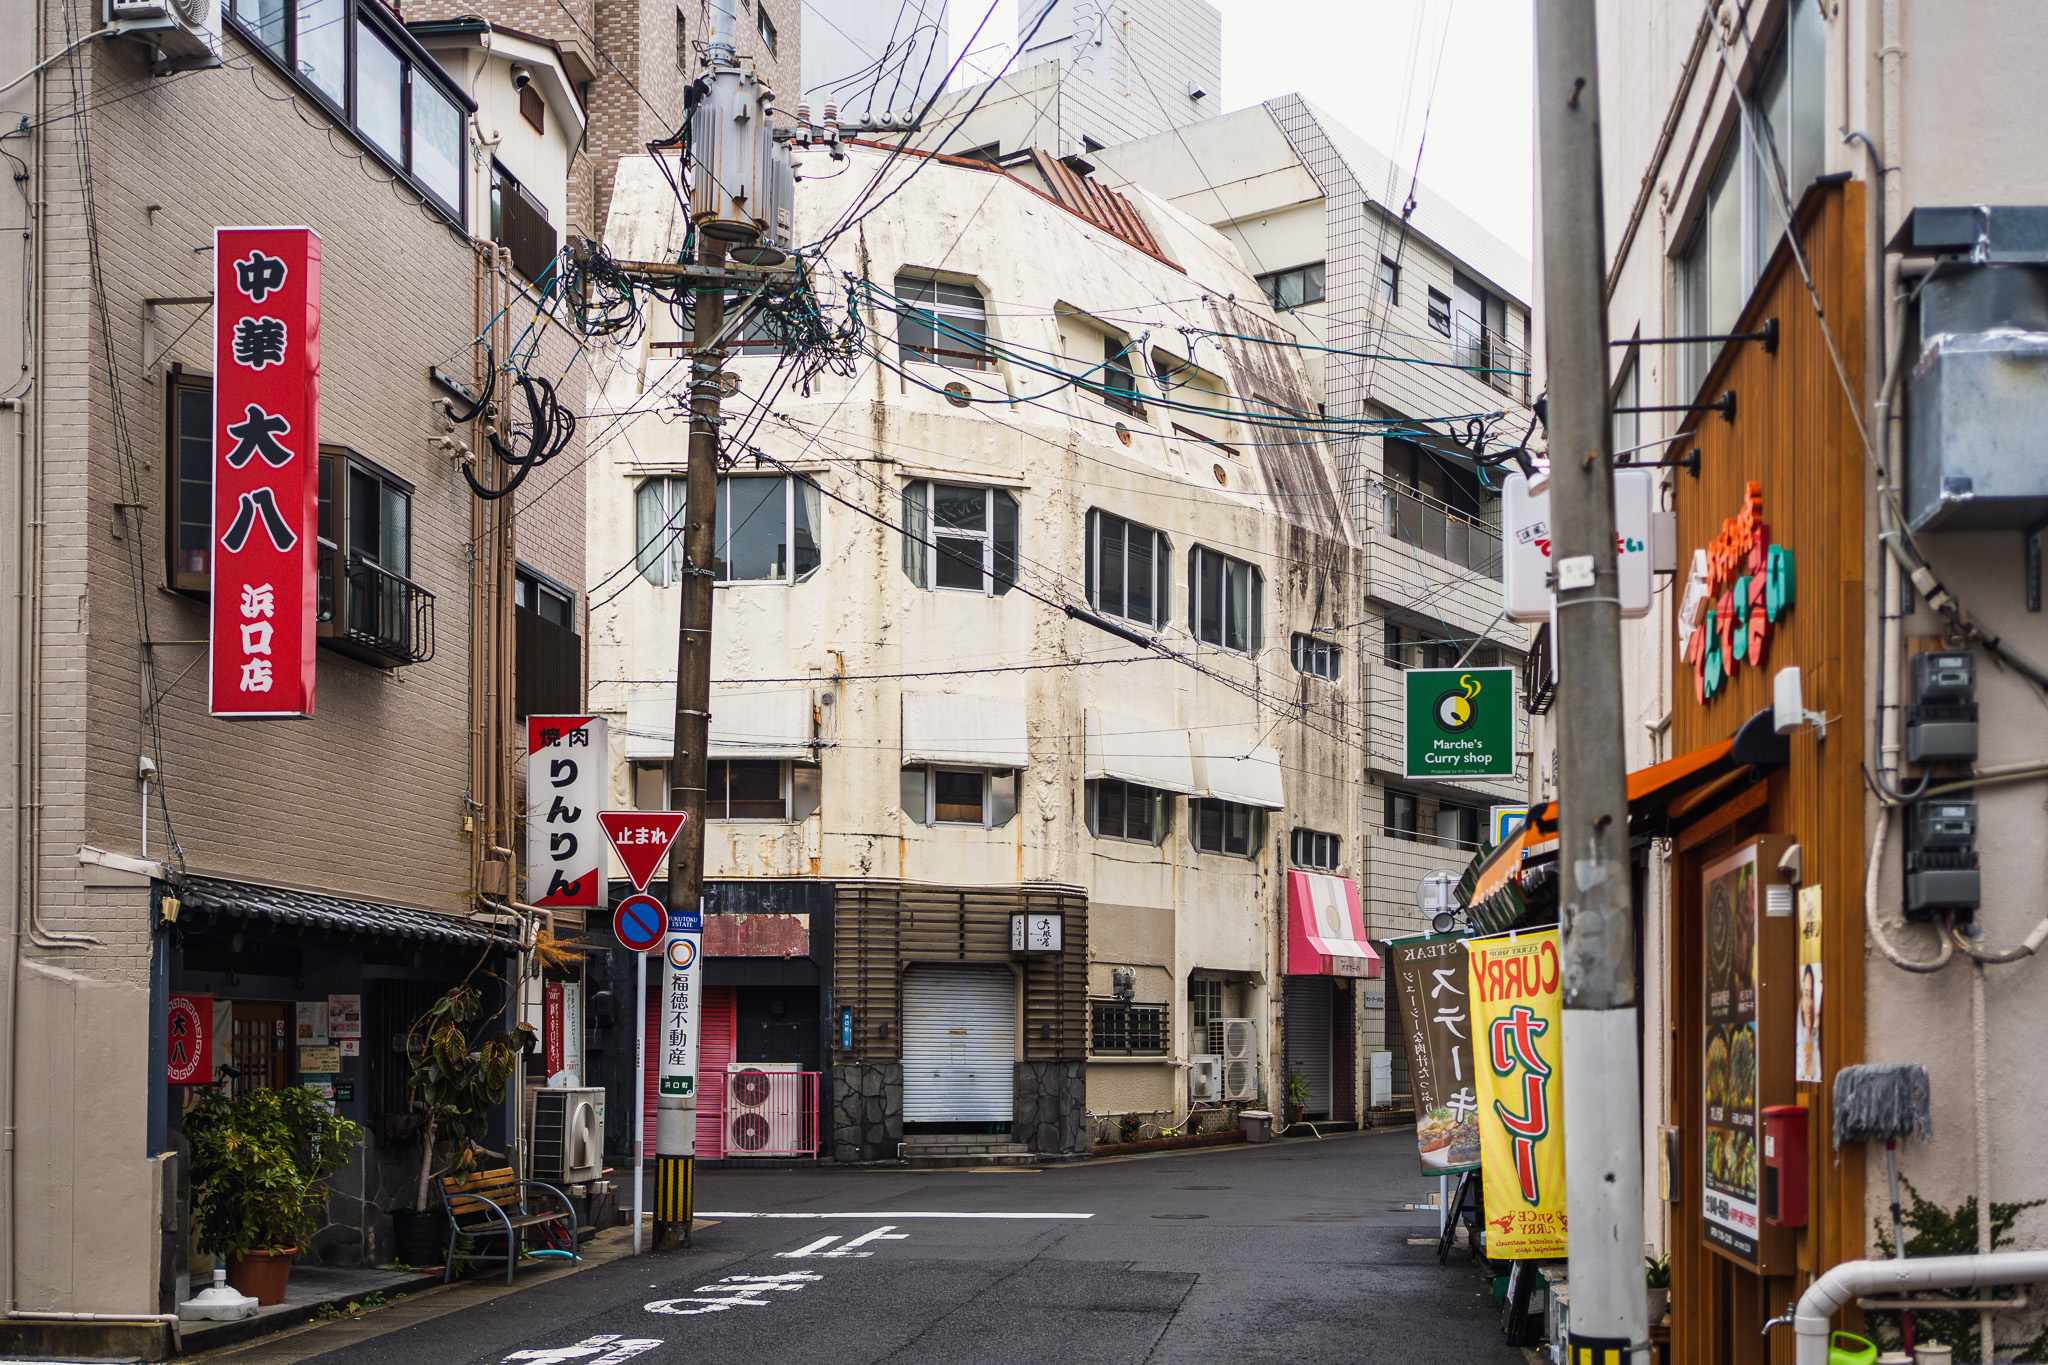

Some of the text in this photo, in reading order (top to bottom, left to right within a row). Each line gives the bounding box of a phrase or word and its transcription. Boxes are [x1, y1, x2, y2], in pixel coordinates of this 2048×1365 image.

[221, 249, 297, 693] 中華 大八 浜口店
[540, 727, 589, 748] 焼肉
[1434, 738, 1483, 749] Marche's
[1424, 752, 1493, 766] Curry shop
[546, 758, 582, 898] りんりん
[616, 826, 668, 845] 止まれ
[171, 1011, 187, 1065] 大八
[668, 973, 689, 1066] 福徳不動産
